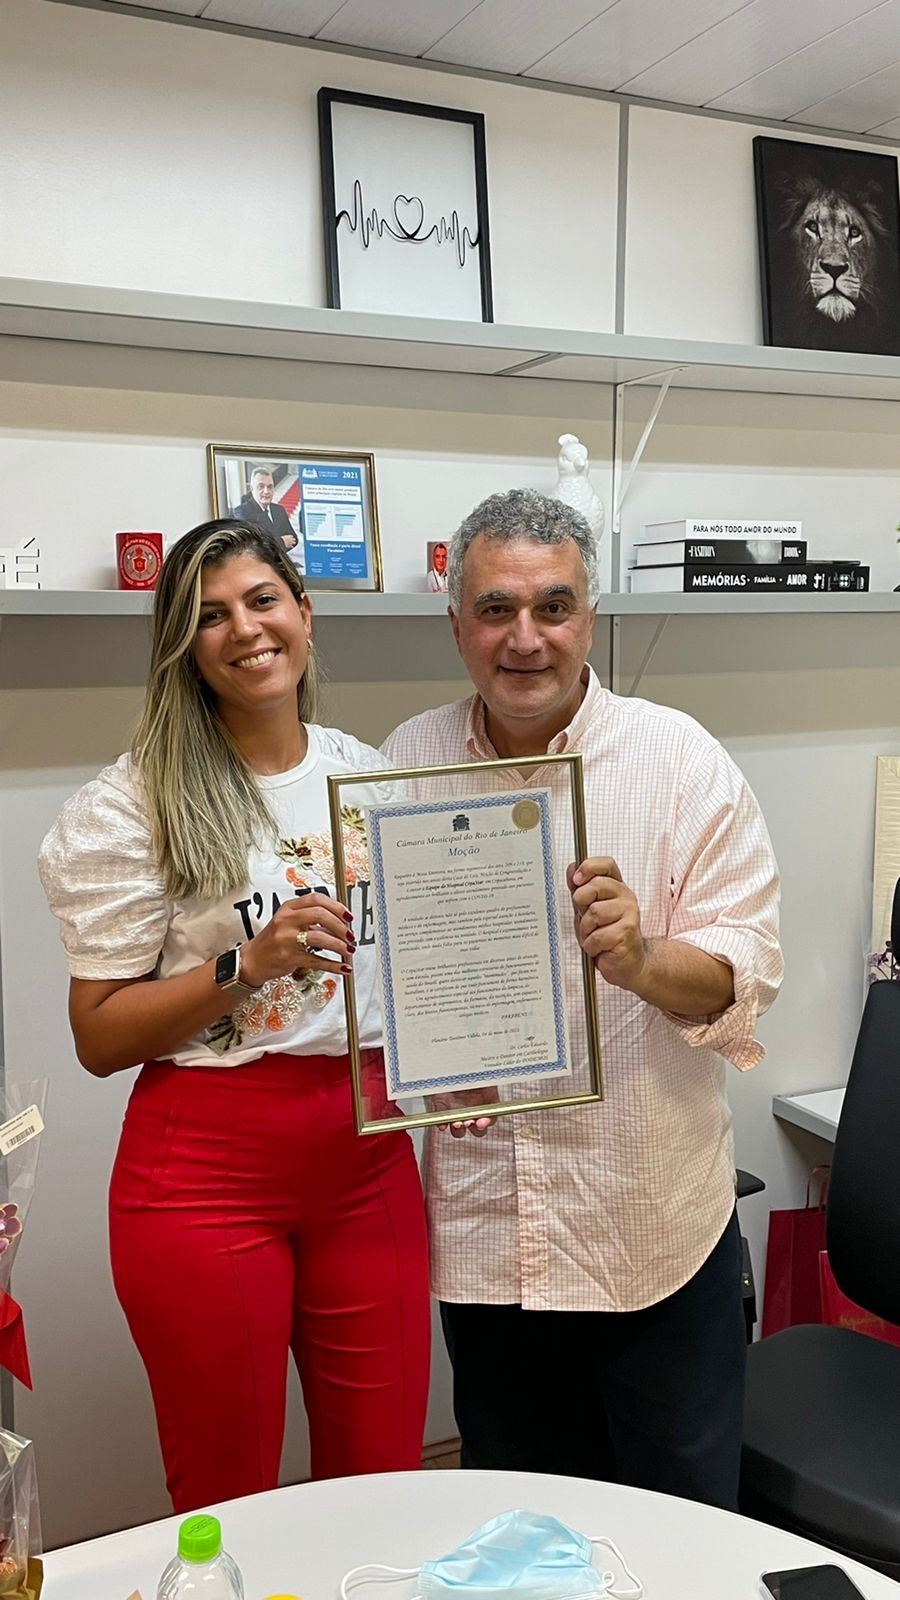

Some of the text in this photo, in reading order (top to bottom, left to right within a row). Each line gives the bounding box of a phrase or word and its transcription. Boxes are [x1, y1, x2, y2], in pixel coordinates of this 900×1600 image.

[342, 471, 358, 479] 2021
[725, 525, 742, 533] TODO
[763, 526, 773, 534] DO
[774, 526, 797, 534] MUNDO
[692, 572, 747, 586] MEMÓRIAS
[754, 575, 776, 583] FAMÍLIA
[786, 573, 808, 585] AMOR
[396, 839, 425, 848] Câmara
[426, 834, 463, 844] Municipal
[463, 833, 473, 841] do
[489, 830, 498, 838] de
[500, 829, 528, 837] Janeiro
[447, 845, 480, 857] Moção
